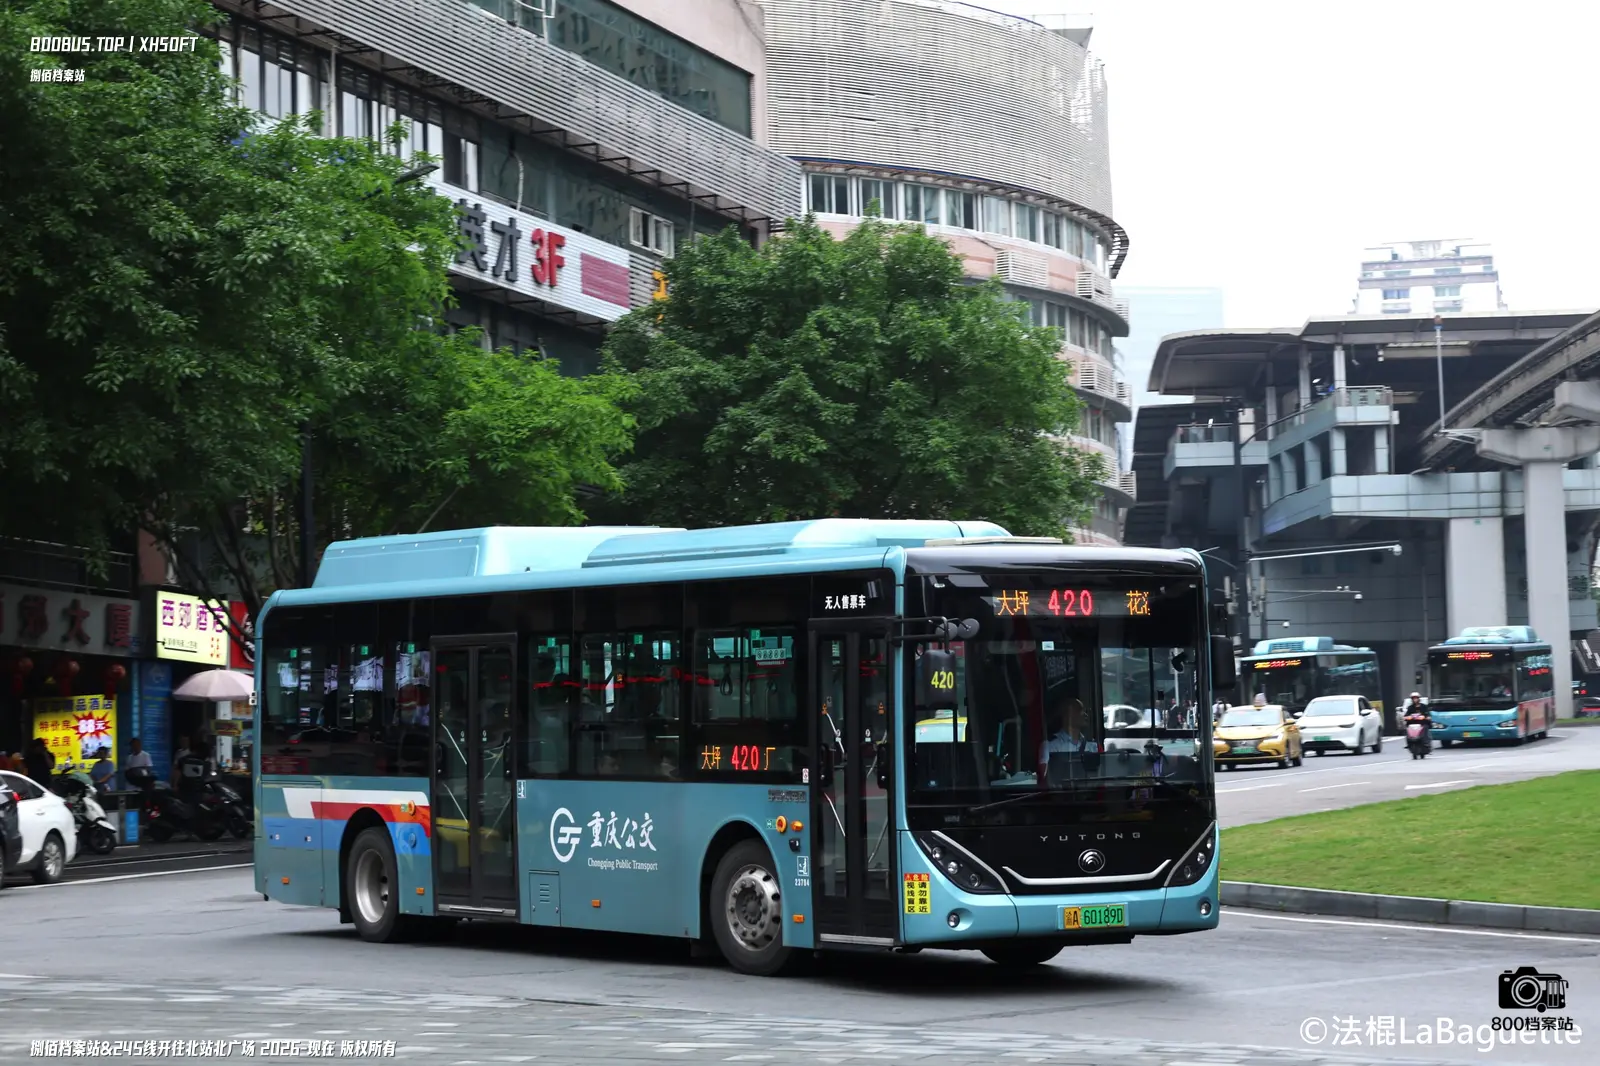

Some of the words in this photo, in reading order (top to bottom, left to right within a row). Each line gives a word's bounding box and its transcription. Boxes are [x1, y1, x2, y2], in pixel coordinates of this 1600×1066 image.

[531, 228, 566, 287] 3F
[824, 594, 867, 610] 无人售票车
[997, 590, 1030, 615] 大坪
[1048, 589, 1093, 616] 420
[931, 671, 954, 689] 420
[701, 745, 721, 770] 大坪
[731, 745, 760, 770] 420
[587, 811, 657, 851] 重庆公交
[1039, 832, 1141, 841] YUTONG
[587, 858, 615, 871] Chongqing
[616, 859, 632, 869] Public
[633, 860, 658, 872] Transport
